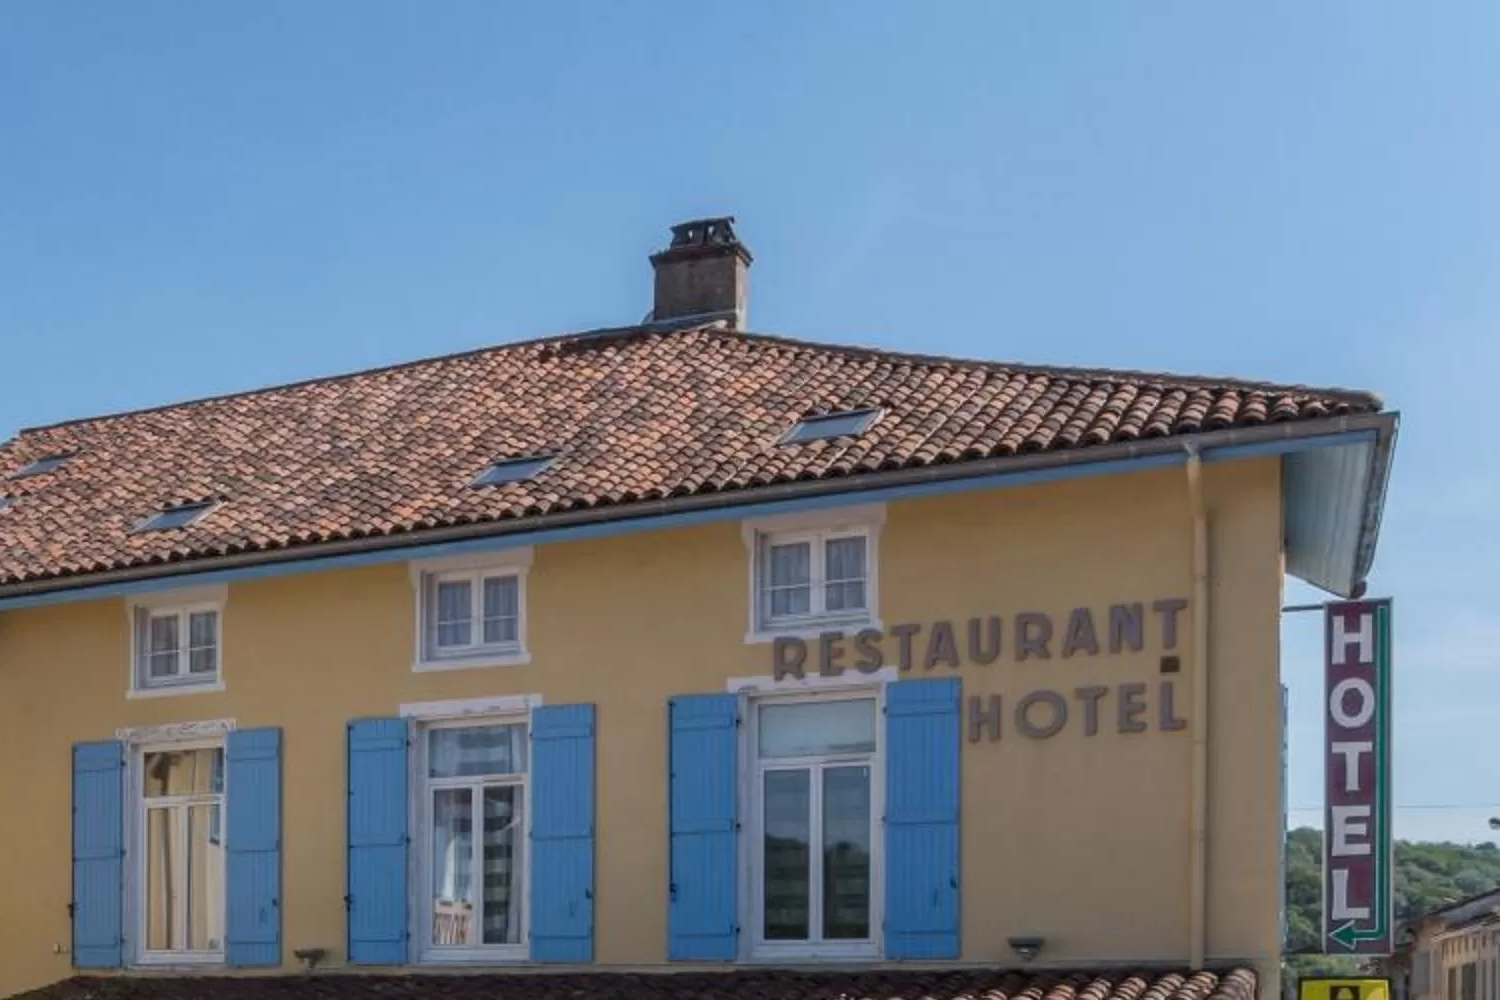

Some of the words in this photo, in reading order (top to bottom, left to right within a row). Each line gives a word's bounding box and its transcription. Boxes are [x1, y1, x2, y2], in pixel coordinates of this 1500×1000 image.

[773, 597, 1188, 682] RESTAURANT
[967, 681, 1188, 743] HOTEL
[1329, 612, 1376, 920] HOTEL
